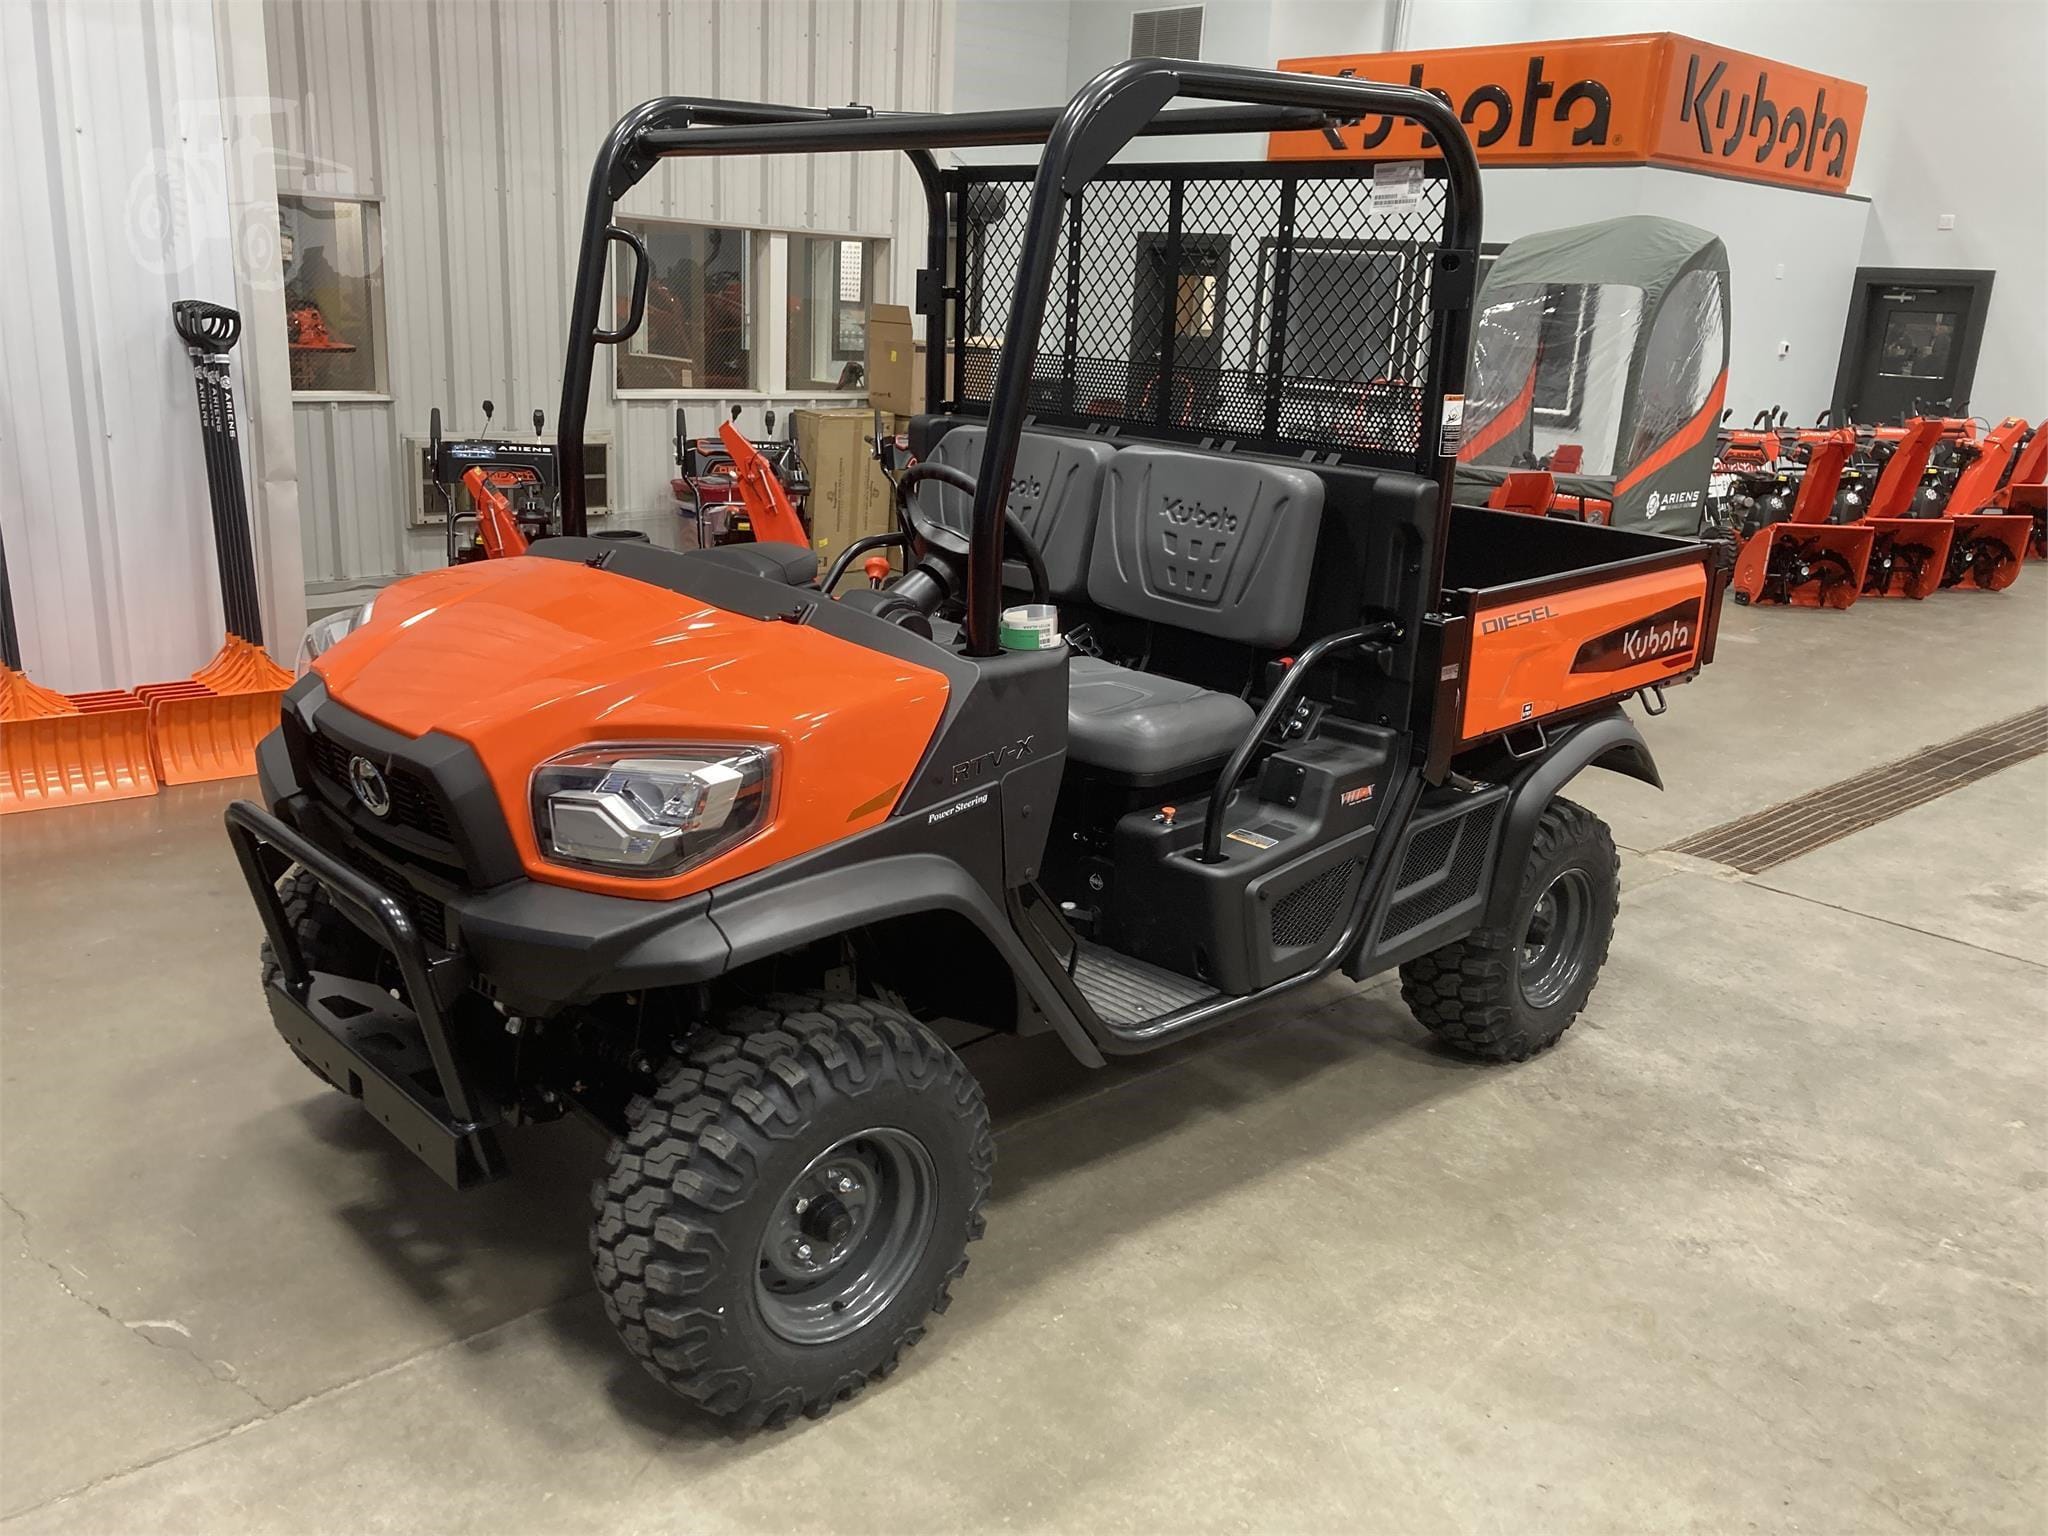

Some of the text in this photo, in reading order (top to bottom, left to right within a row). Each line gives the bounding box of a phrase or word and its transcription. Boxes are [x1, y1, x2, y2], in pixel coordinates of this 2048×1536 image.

[1297, 56, 1613, 150] bota
[1679, 53, 1848, 178] Kubota
[224, 392, 236, 438] ARIENS
[498, 445, 551, 453] ARIENS
[1160, 496, 1238, 535] Kubota
[1661, 490, 1700, 504] ARIENS
[1481, 605, 1559, 636] DIESEL
[1622, 619, 1689, 661] Kubota
[952, 734, 1035, 785] RTV-X
[928, 794, 988, 825] Power Steering
